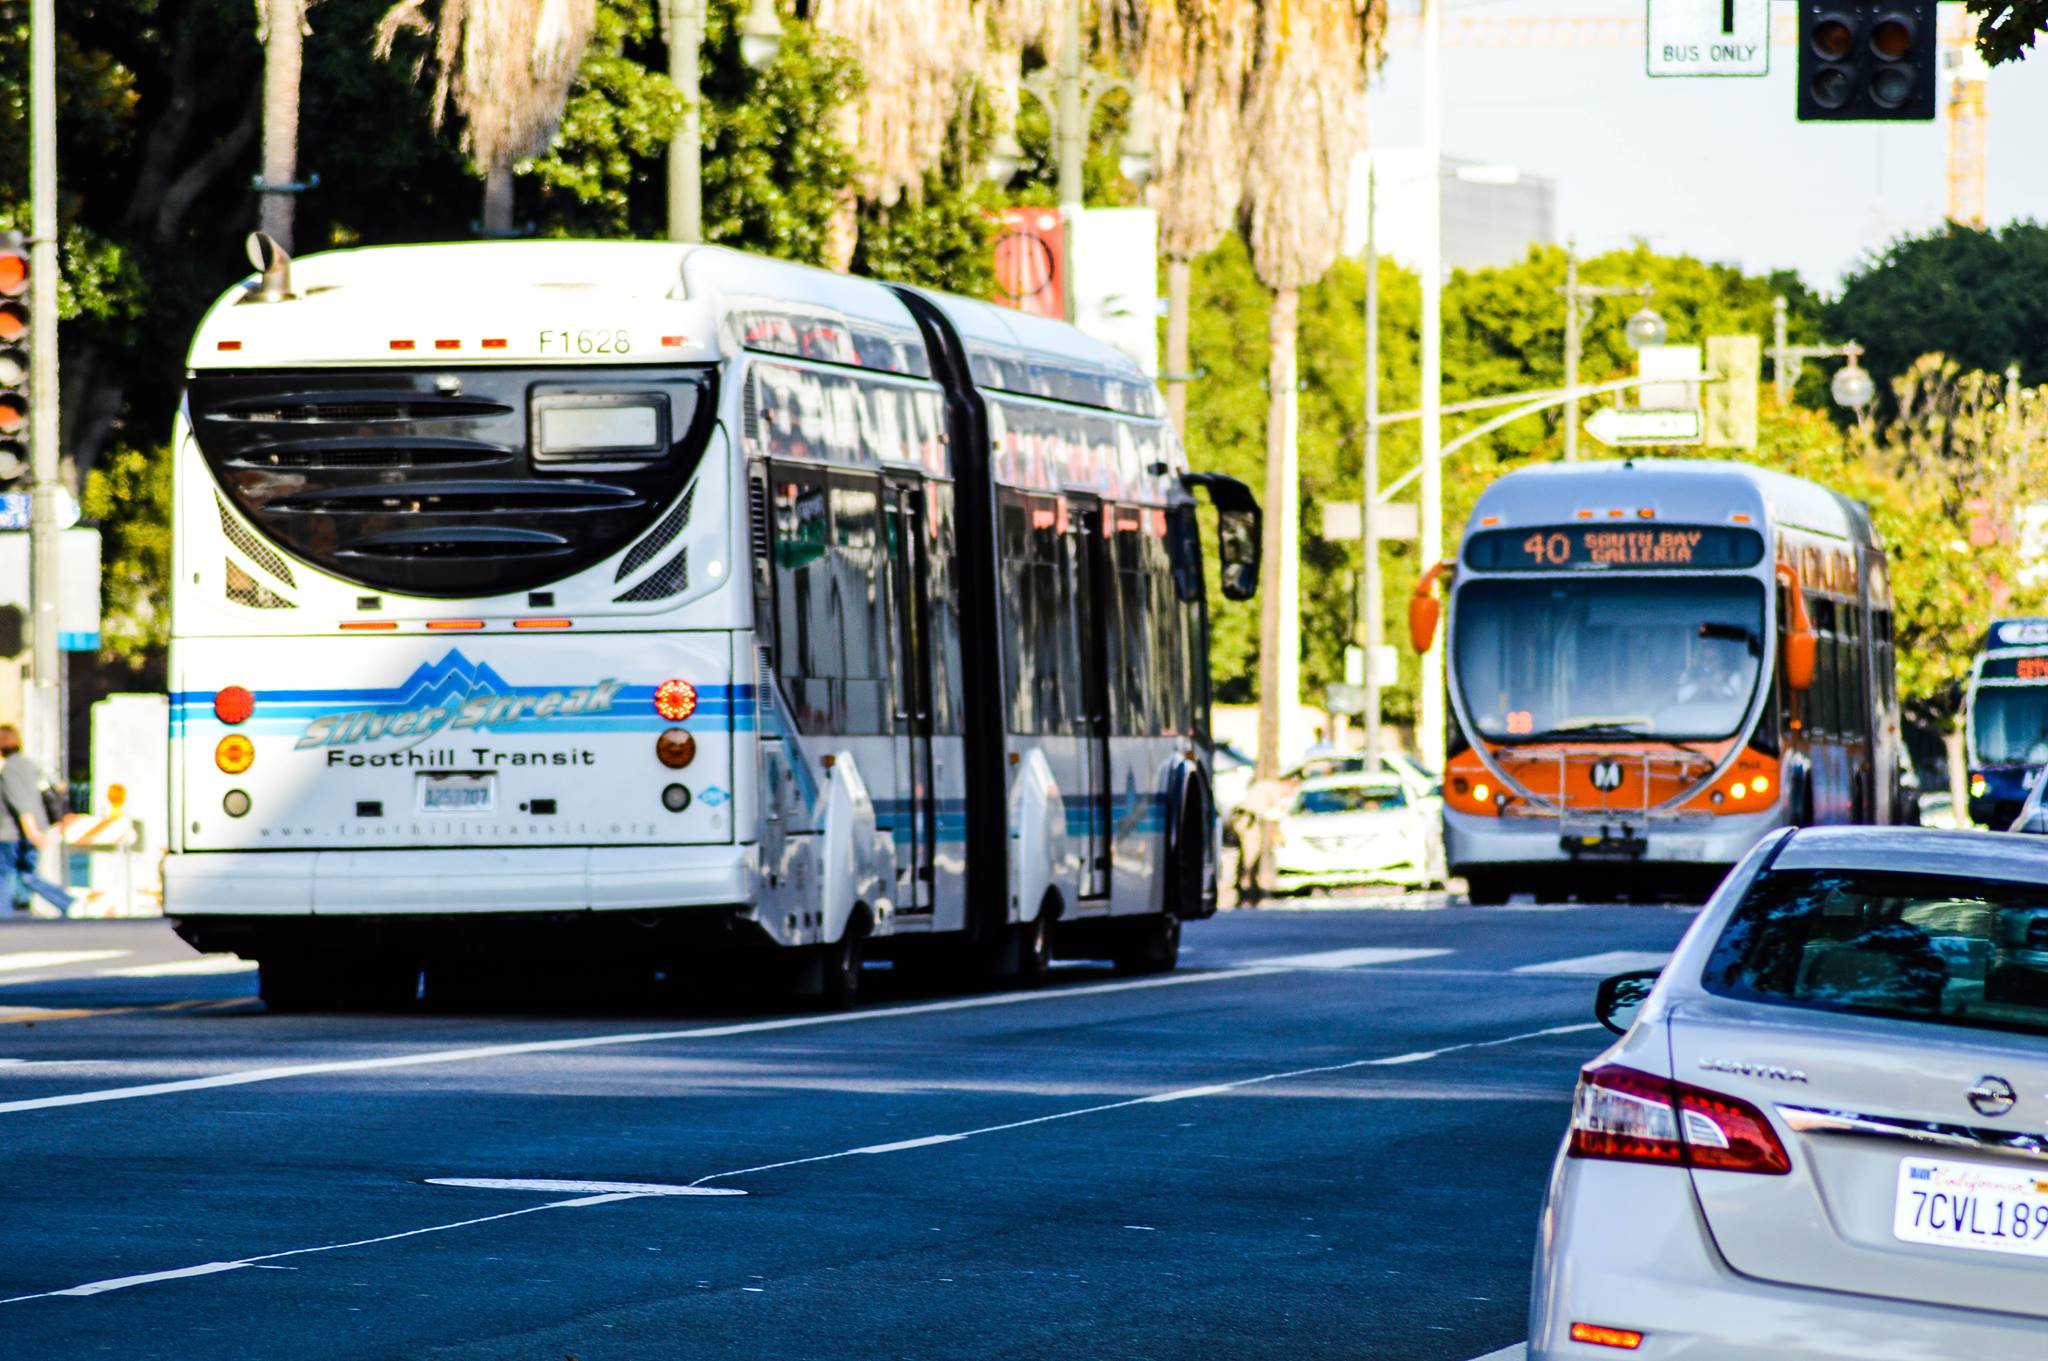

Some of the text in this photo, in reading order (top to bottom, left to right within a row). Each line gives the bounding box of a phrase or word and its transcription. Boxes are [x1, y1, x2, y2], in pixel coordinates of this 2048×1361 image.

[1663, 44, 1758, 62] BUS ONLY
[539, 329, 631, 354] F1628
[1523, 530, 1701, 564] 40 SOUTH BAY
[294, 678, 629, 750] Silver Streak
[327, 748, 595, 767] Foothill Transit
[1698, 1058, 1808, 1084] SENTRA
[1912, 1190, 2048, 1240] 7CVL189
